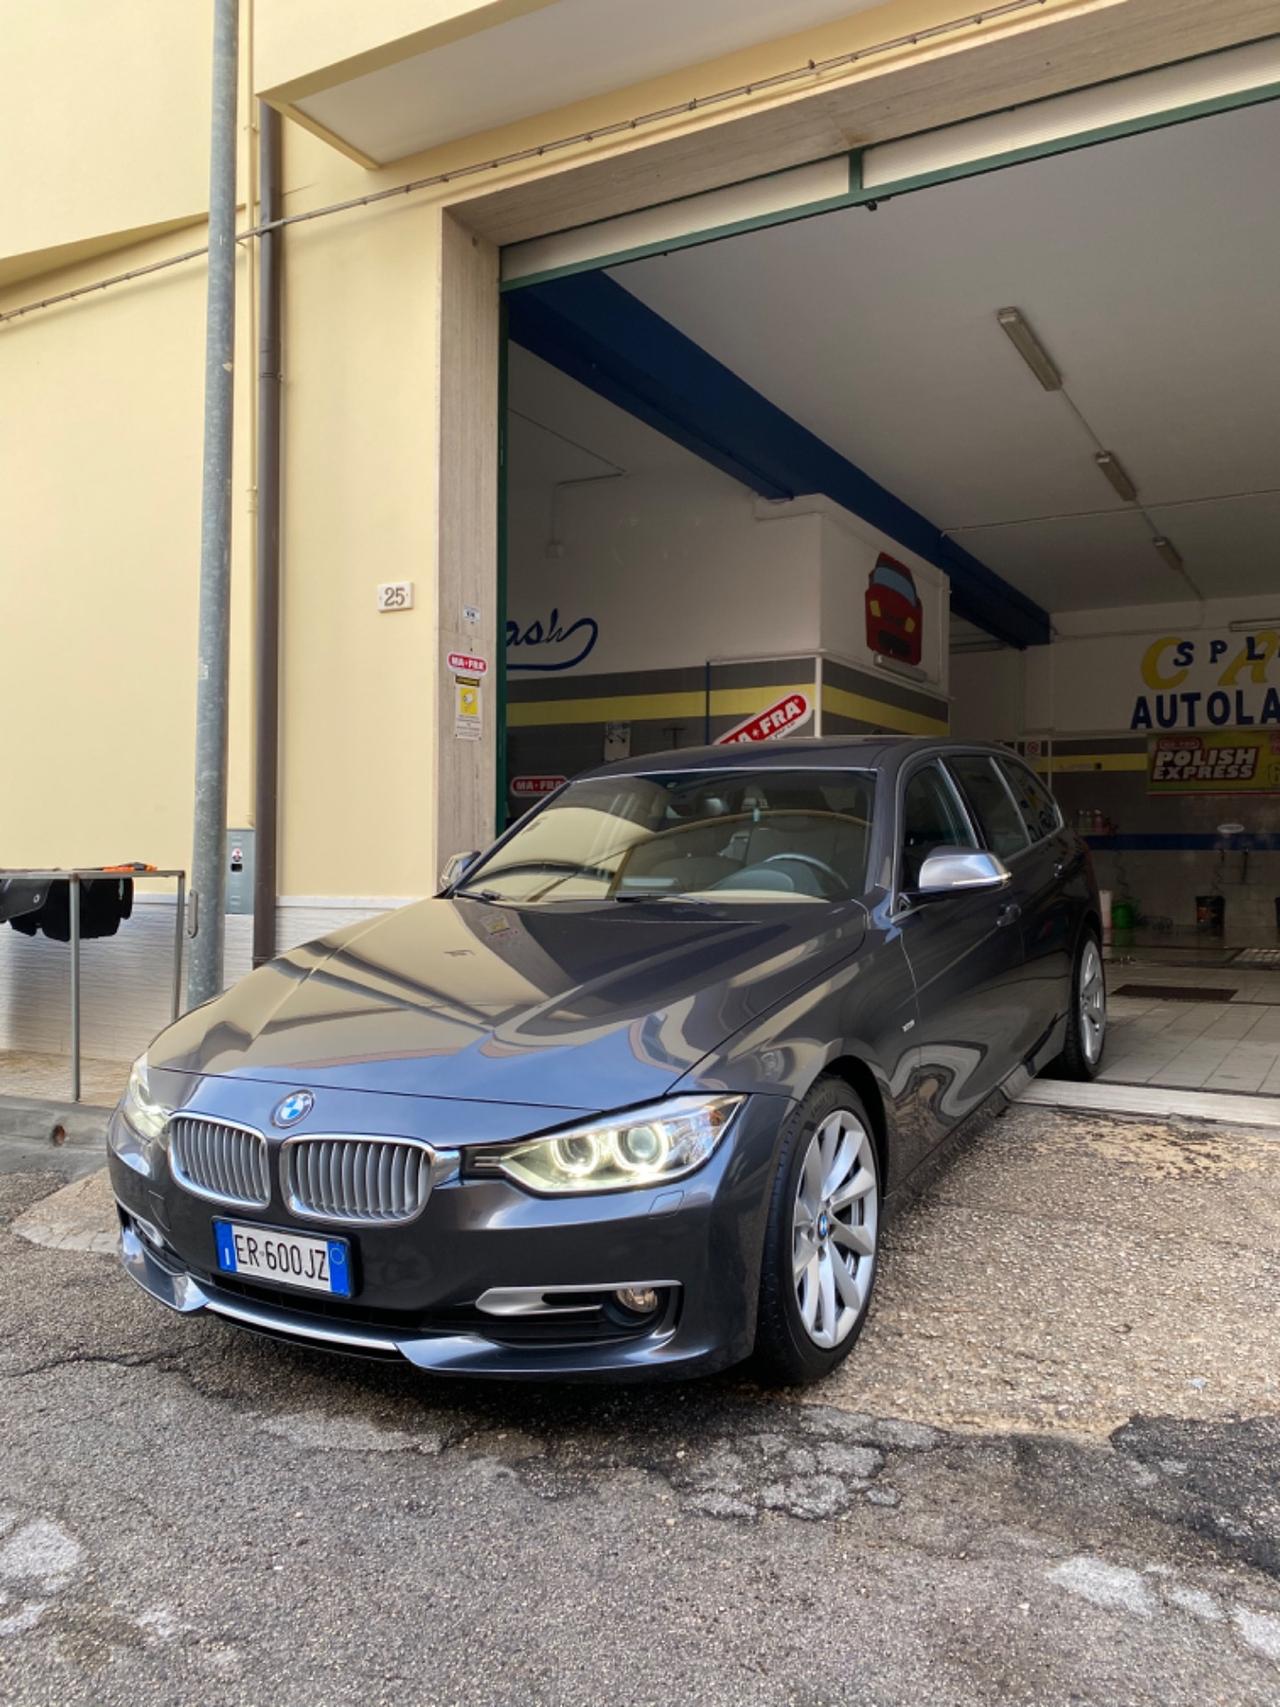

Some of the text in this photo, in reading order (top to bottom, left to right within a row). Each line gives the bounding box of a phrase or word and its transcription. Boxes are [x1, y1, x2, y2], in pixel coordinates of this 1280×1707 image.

[384, 587, 406, 607] 25
[1173, 636, 1280, 667] SPL
[1130, 687, 1280, 730] AUTOLA
[1156, 748, 1256, 767] POLISH
[1152, 764, 1253, 780] EXPRESS
